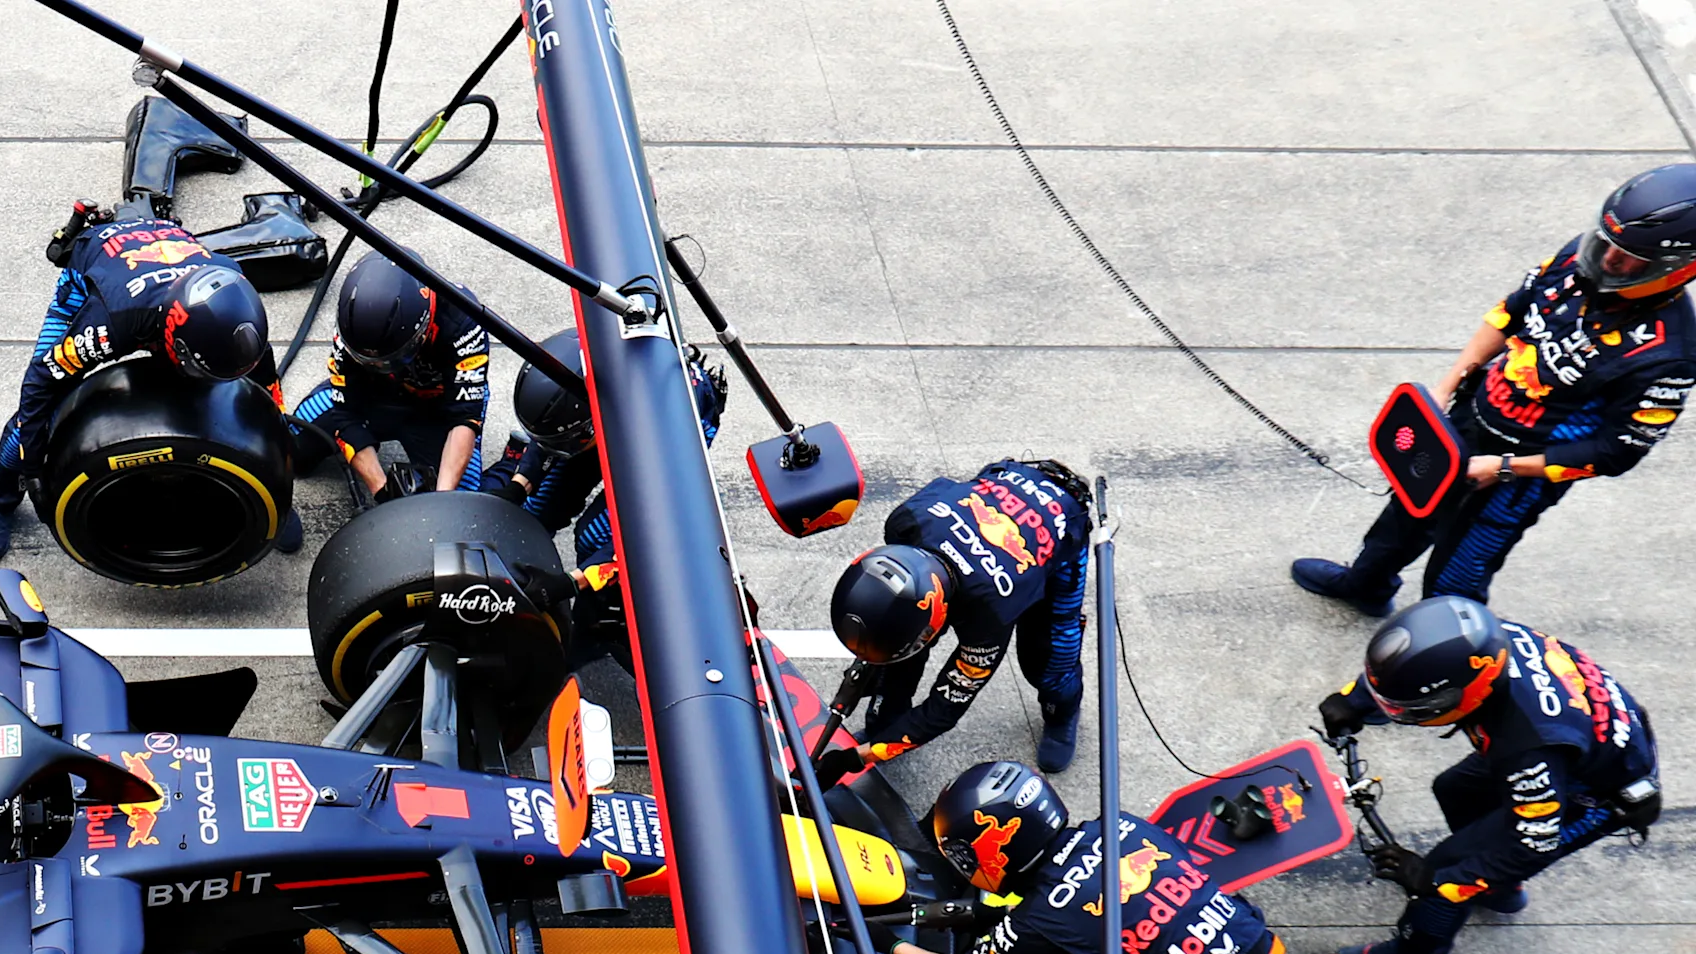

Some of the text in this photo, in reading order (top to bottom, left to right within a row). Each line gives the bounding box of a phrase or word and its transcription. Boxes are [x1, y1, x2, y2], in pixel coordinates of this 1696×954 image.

[531, 0, 560, 59] CLE
[42, 350, 65, 380] VISA
[83, 325, 98, 358] Claro
[107, 446, 174, 471] PIRELLI
[927, 501, 1014, 597] ORACLE
[1021, 506, 1056, 567] Red
[438, 592, 516, 615] Hard Rock
[6, 727, 19, 755] TAG
[571, 713, 588, 796] BRAKES
[195, 747, 218, 845] ORACLE
[247, 763, 302, 828] TAG HEUER
[506, 786, 530, 841] VISA
[598, 799, 612, 828] WOLF
[1261, 785, 1291, 834] Red Bull
[86, 805, 116, 849] Bull
[610, 797, 637, 854] PIRELLI
[147, 871, 271, 907] BYBIT
[1155, 859, 1210, 908] Bull
